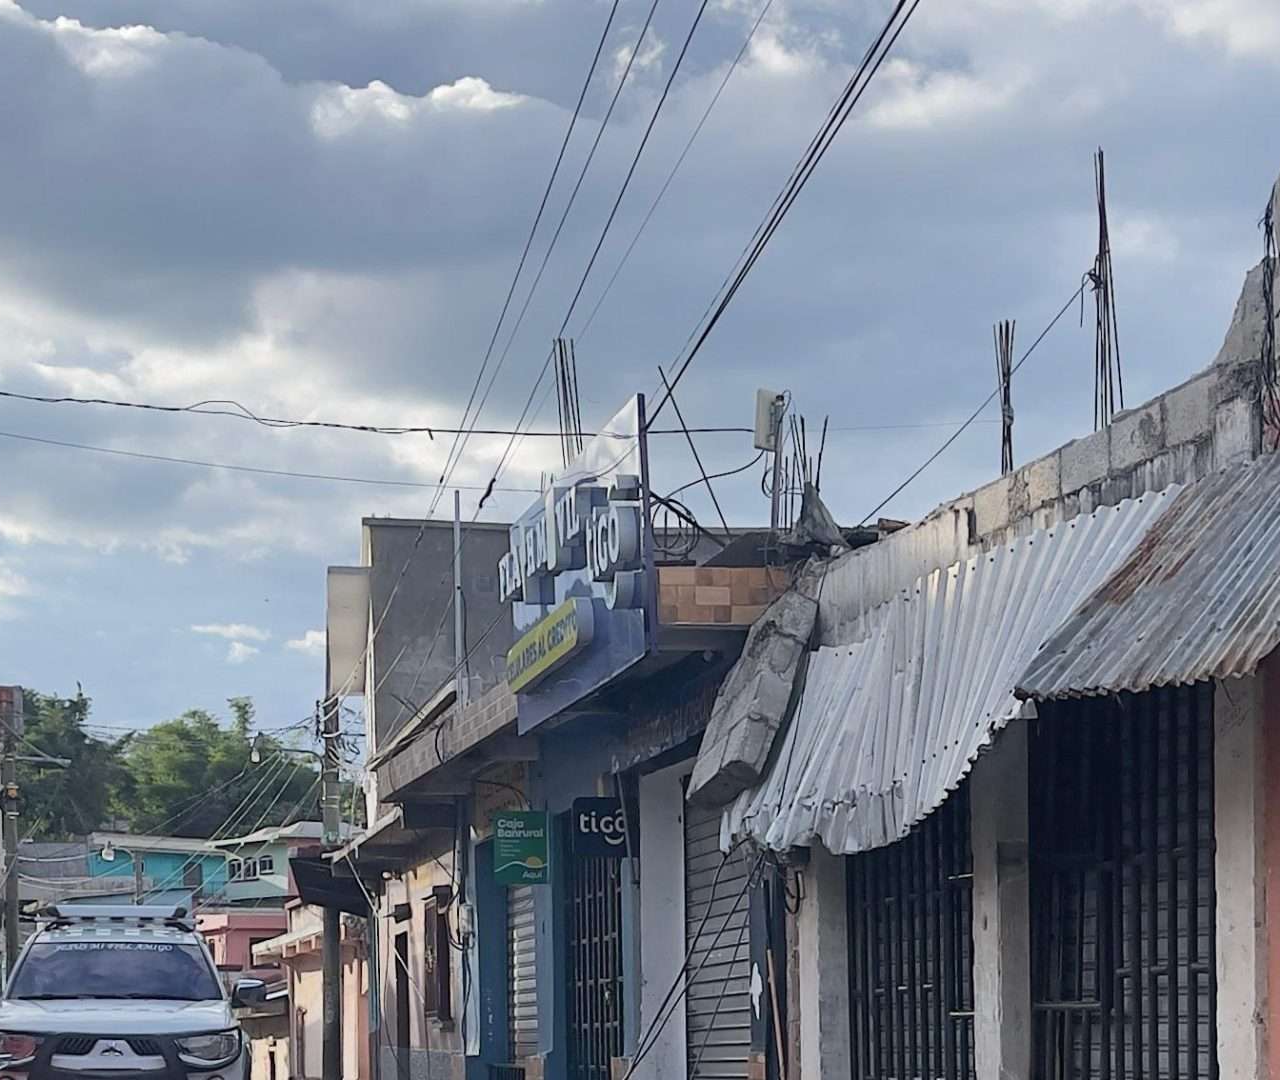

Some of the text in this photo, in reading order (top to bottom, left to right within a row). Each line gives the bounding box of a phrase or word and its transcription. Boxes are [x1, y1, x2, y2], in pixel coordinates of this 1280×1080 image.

[497, 819, 524, 830] Caja
[580, 810, 625, 833] tigo
[497, 828, 544, 838] Banrural
